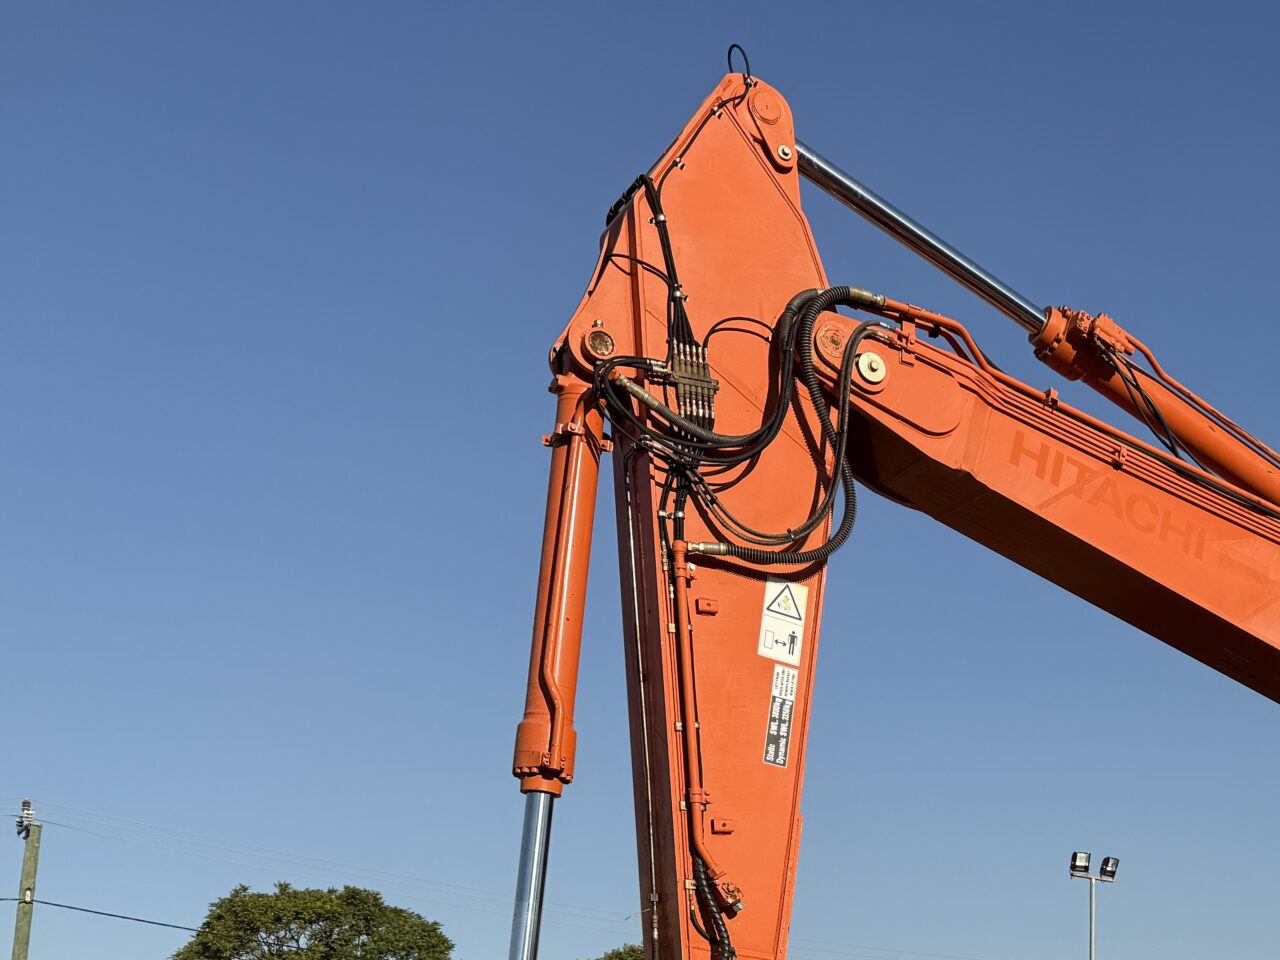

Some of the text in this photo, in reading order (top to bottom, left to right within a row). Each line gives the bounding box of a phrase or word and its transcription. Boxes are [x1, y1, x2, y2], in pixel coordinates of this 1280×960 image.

[1009, 429, 1208, 561] HITACHI
[766, 743, 776, 761] Static
[775, 737, 787, 764] Dynamic
